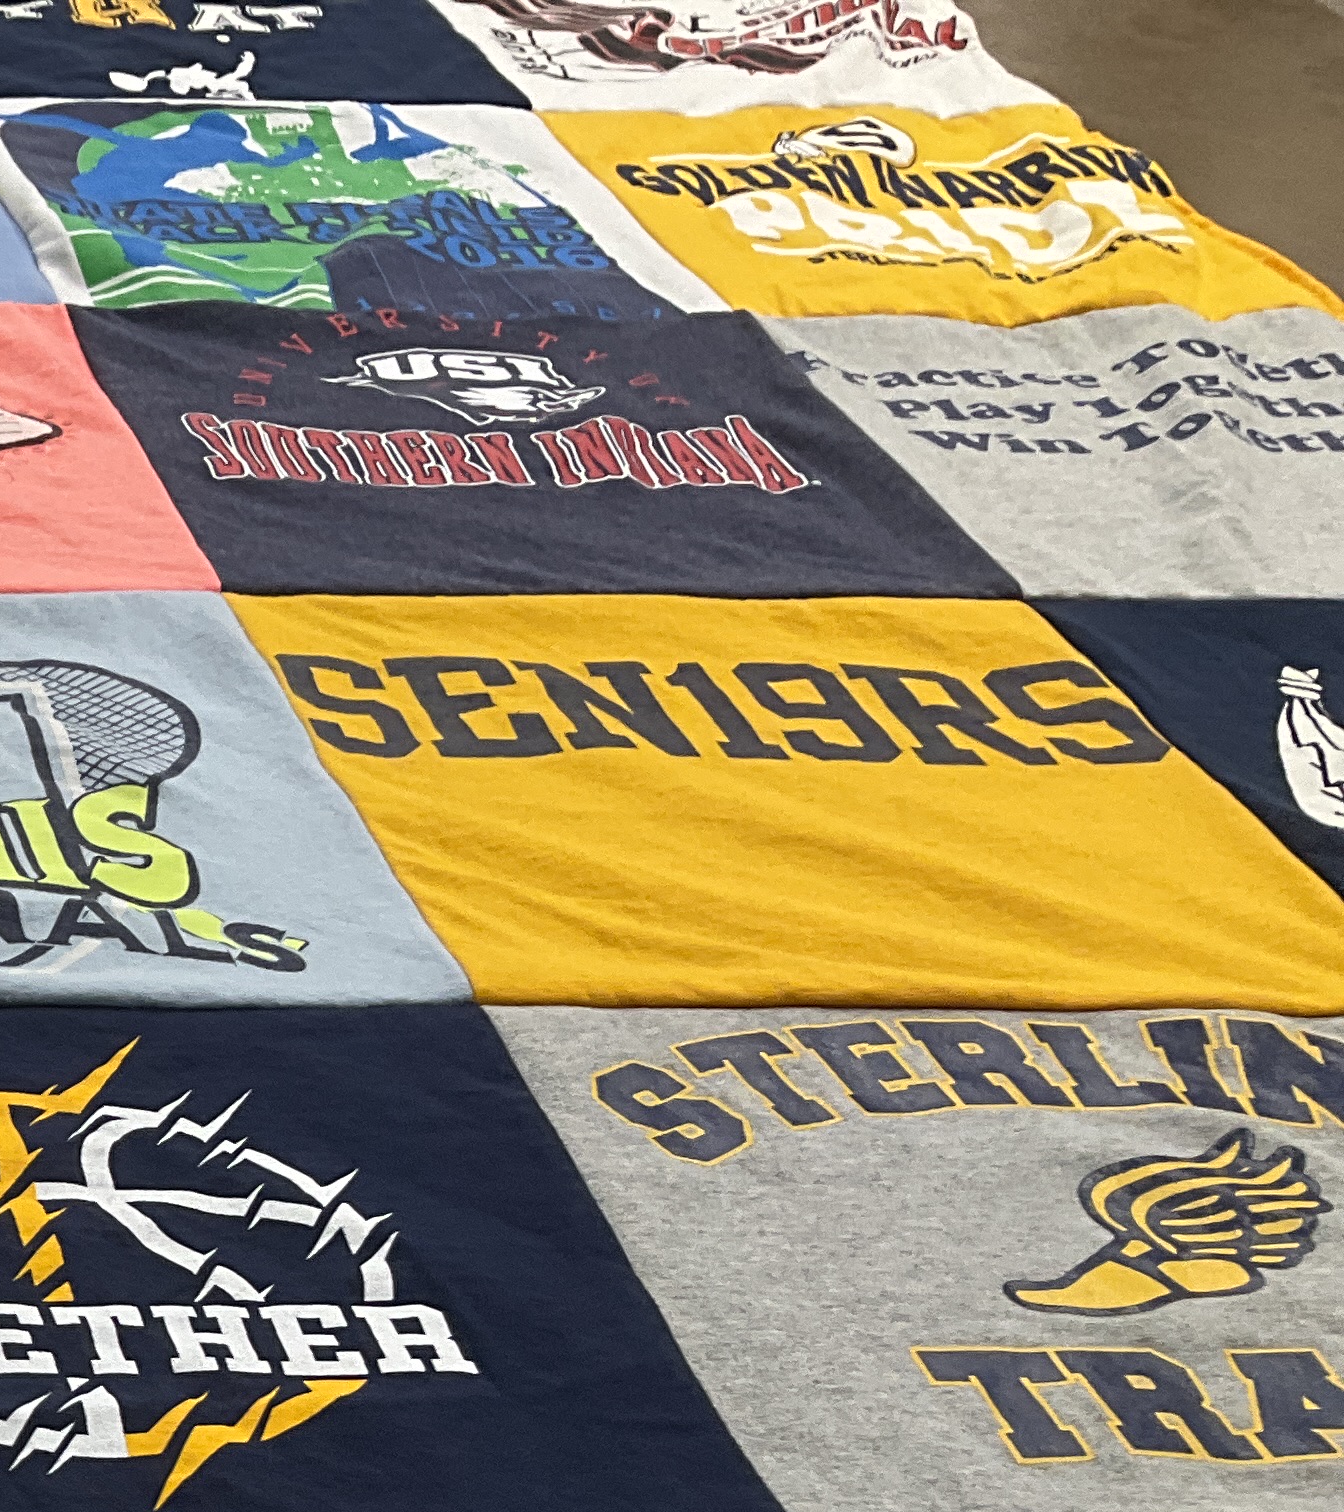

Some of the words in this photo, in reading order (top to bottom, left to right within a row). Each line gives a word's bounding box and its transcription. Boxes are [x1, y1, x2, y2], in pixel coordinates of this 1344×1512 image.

[614, 152, 879, 207] GOLDEN
[369, 352, 560, 386] USI
[882, 399, 1057, 424] Play
[182, 410, 534, 488] SOUTHERN
[532, 414, 805, 494] INDIANA
[908, 428, 1093, 455] Win
[275, 654, 1177, 766] SEN19RS
[910, 1345, 1344, 1465] TRA
